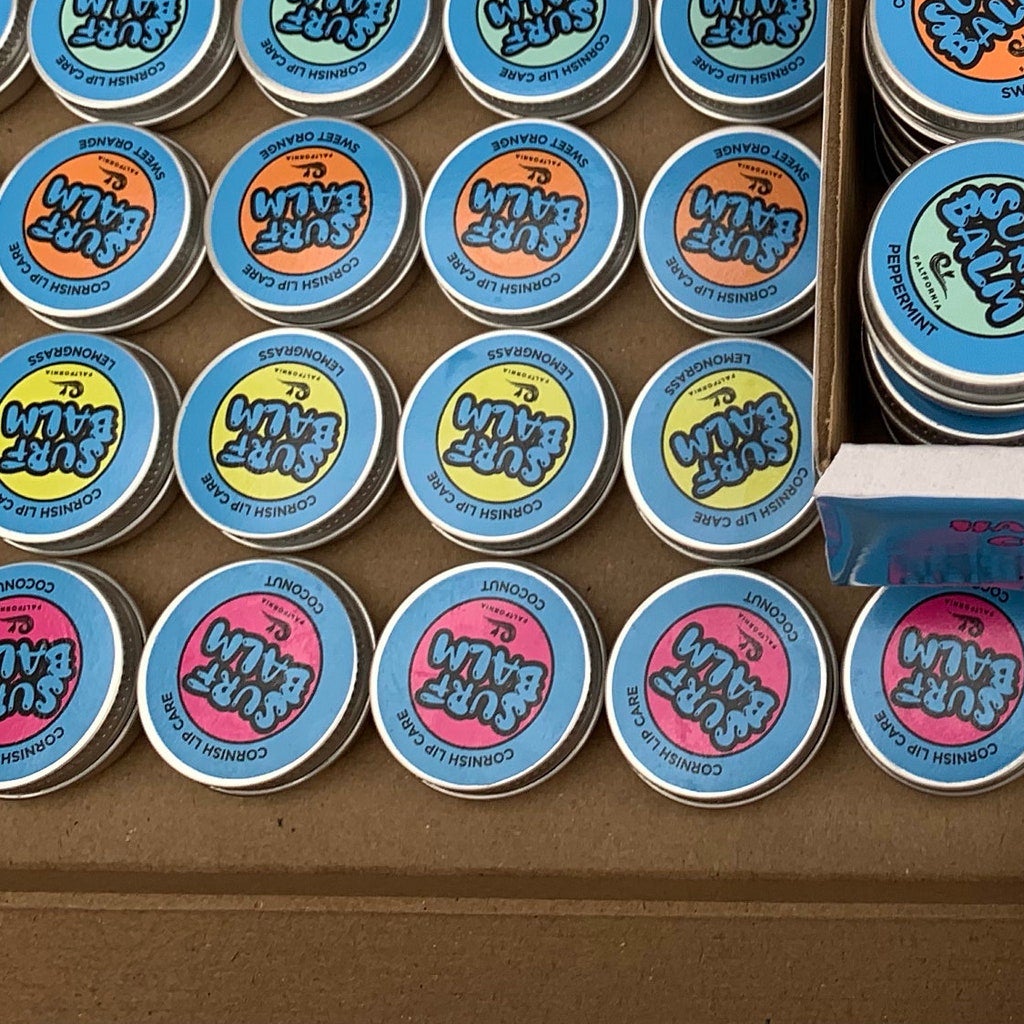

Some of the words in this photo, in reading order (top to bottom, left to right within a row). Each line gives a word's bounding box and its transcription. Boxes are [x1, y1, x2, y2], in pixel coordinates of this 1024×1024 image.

[68, 16, 170, 51] SURF
[490, 134, 548, 151] ORANGE
[549, 137, 589, 167] SWEET
[470, 179, 580, 232] BALM
[461, 215, 569, 261] SURF
[445, 250, 476, 283] CARE
[498, 271, 562, 295] CORNISH
[908, 254, 944, 311] FALTFORNIA
[474, 276, 496, 292] LIP
[887, 242, 937, 337] PEPPERMINT
[486, 346, 573, 379] LEMONGRASS
[453, 394, 567, 456] BALM
[443, 432, 553, 486] SURF
[425, 469, 456, 506] CARE
[453, 499, 476, 517] LIP
[478, 497, 543, 521] CORNISH
[480, 579, 547, 611] COCONUT
[427, 629, 545, 704] BALM
[415, 671, 528, 734] SURF
[396, 709, 426, 748] CARE
[423, 742, 446, 762] LIP
[447, 747, 514, 768] CORNISH
